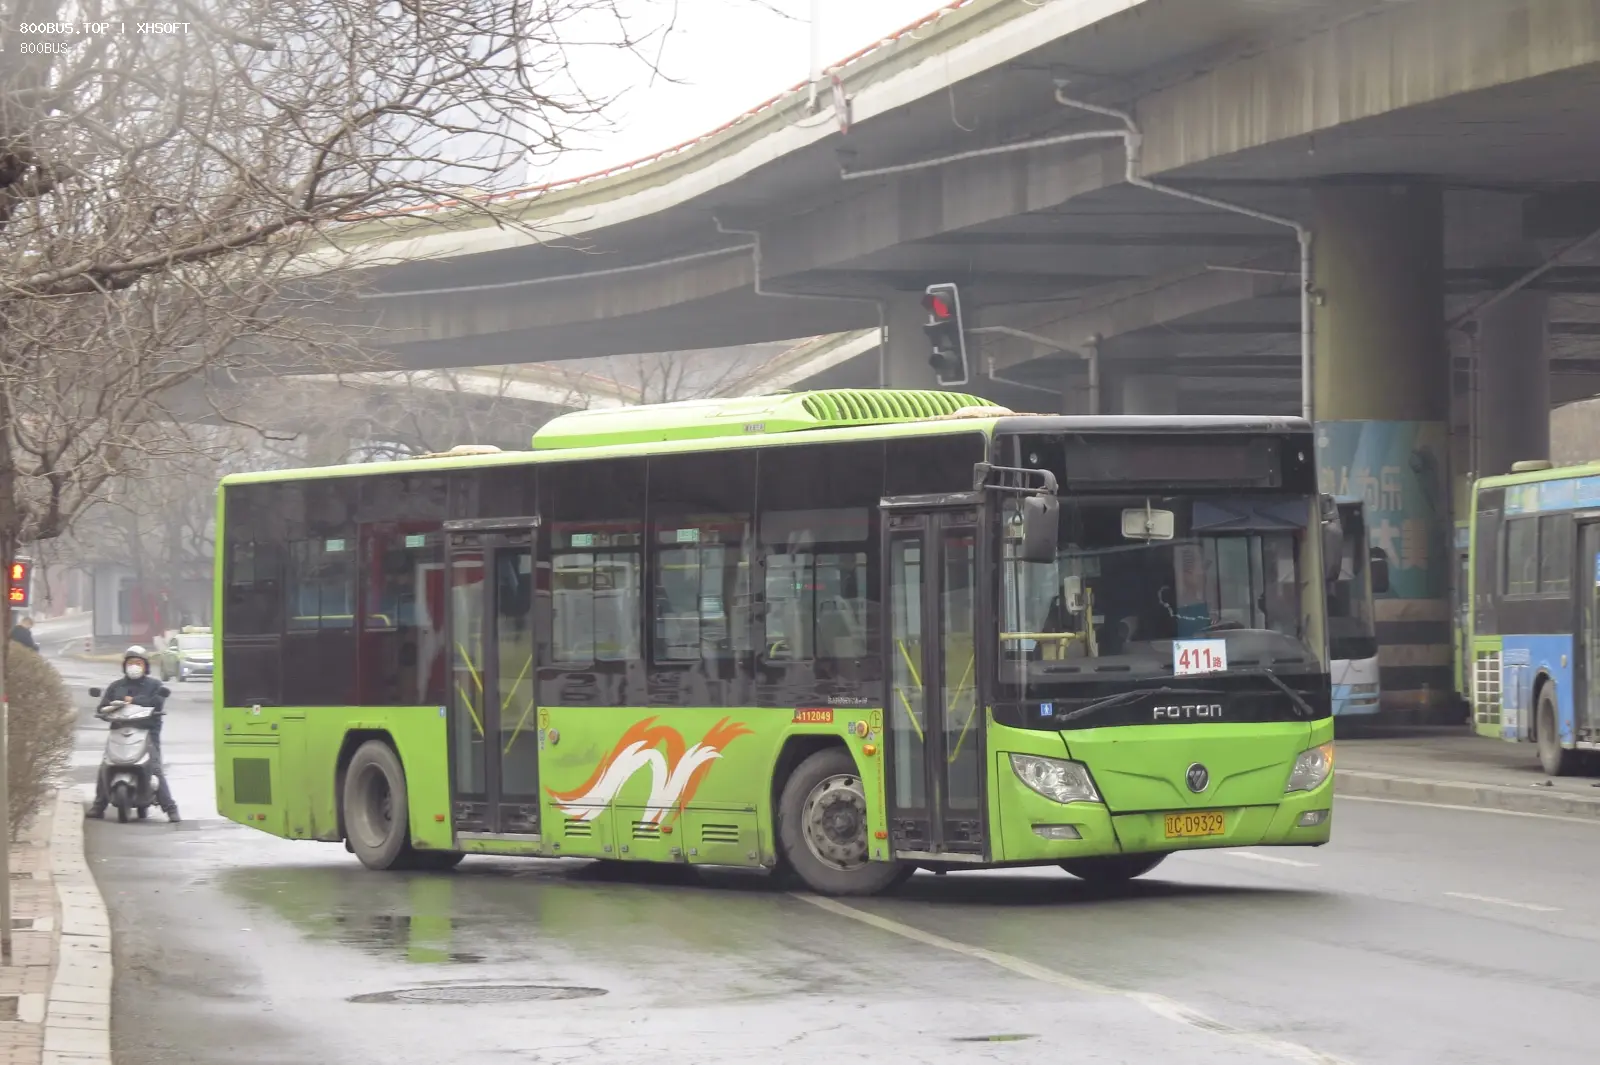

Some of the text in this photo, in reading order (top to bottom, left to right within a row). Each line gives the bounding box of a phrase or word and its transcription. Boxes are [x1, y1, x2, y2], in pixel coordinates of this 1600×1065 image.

[1179, 648, 1222, 669] 411路
[795, 710, 831, 722] 4112049
[1153, 704, 1222, 720] FOTON
